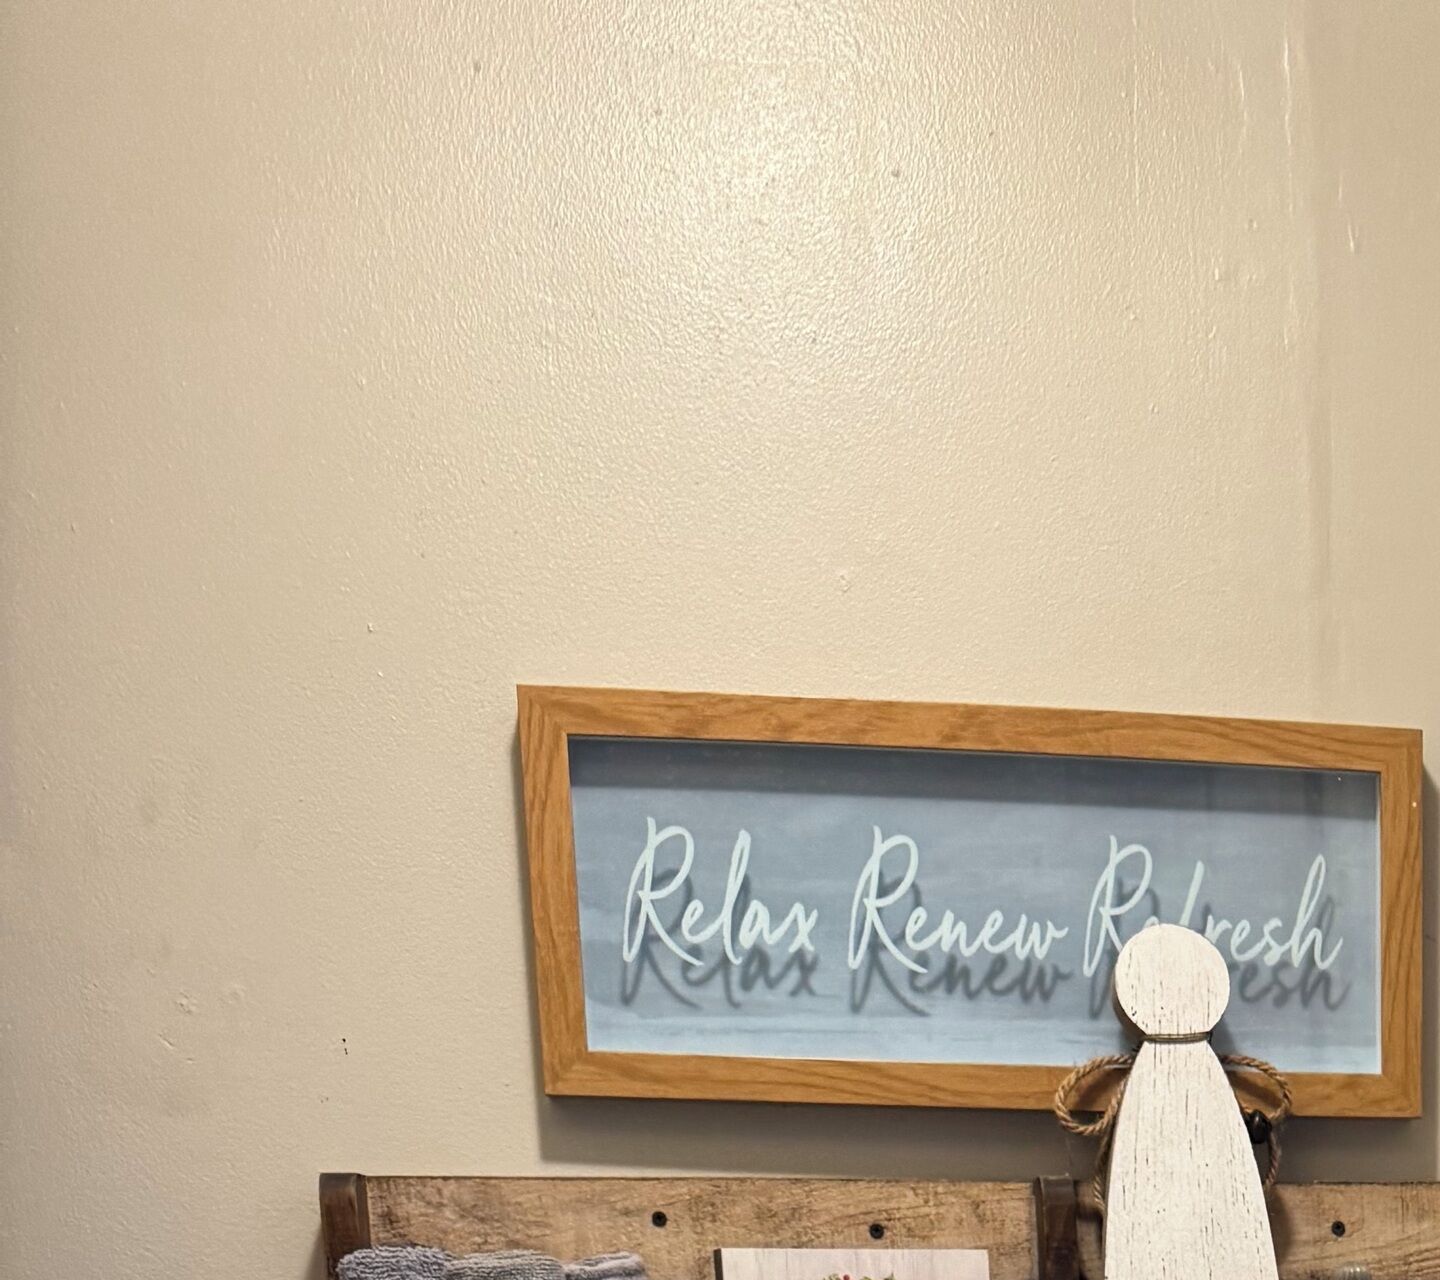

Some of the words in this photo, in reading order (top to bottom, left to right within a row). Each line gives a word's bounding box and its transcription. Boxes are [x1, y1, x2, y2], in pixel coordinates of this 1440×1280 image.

[622, 816, 818, 966] Relax
[847, 825, 1070, 973] Renew
[1083, 835, 1343, 977] Rresh
